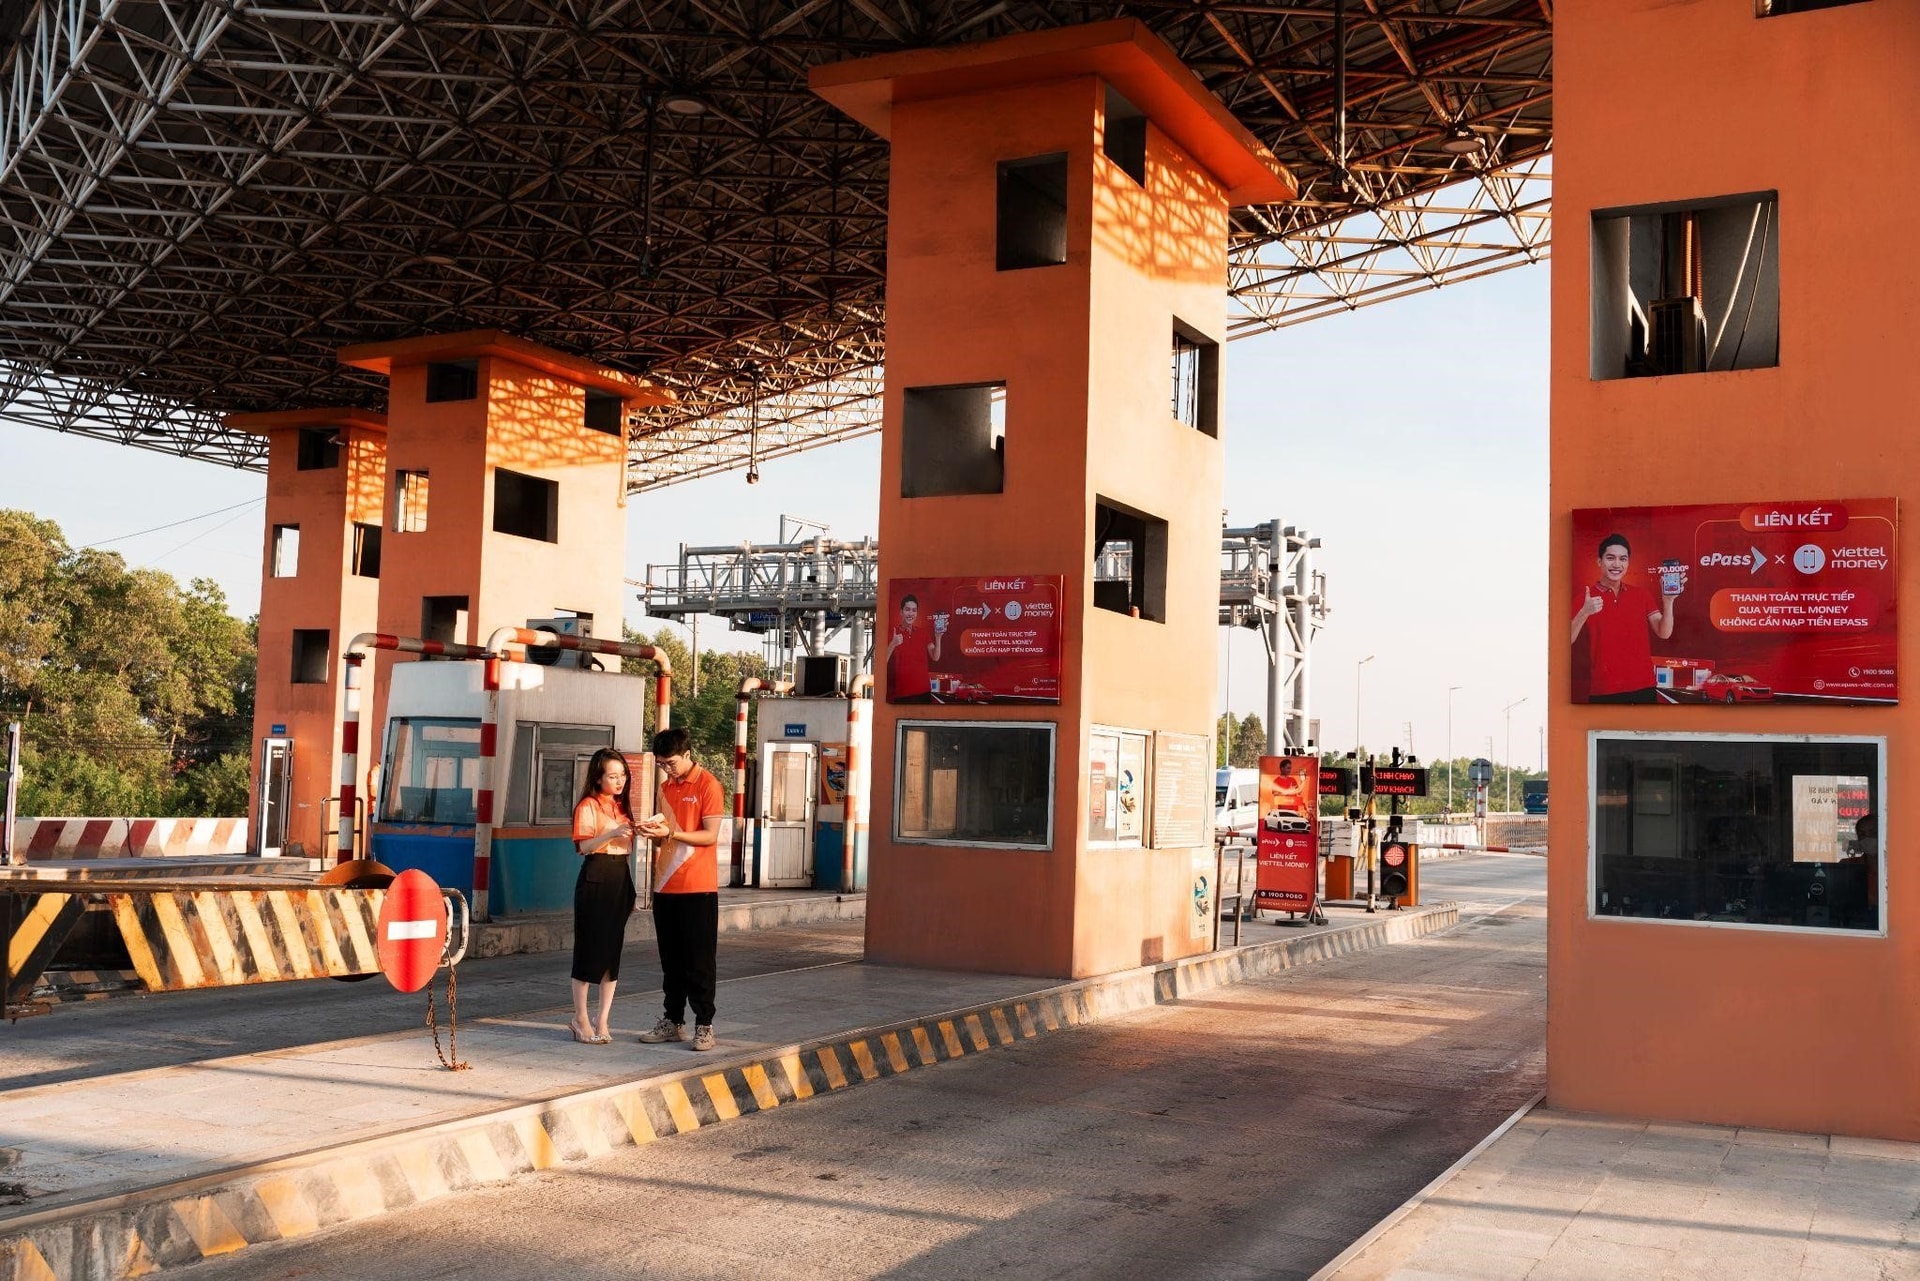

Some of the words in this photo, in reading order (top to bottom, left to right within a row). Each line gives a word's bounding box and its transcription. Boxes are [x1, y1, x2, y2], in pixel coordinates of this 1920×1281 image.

[1754, 511, 1793, 526] LIÊN
[1798, 508, 1832, 525] KẾT
[1832, 547, 1886, 558] viettel
[1700, 552, 1751, 566] ePass
[1832, 559, 1888, 570] money
[984, 580, 1005, 590] LIÊN
[1008, 578, 1026, 590] KẾT
[1730, 594, 1766, 602] THANH
[1769, 592, 1798, 602] TOÁN
[1800, 593, 1828, 602] TRỰC
[1832, 590, 1855, 601] TIẾP
[956, 606, 983, 615] ePass
[1738, 606, 1761, 614] QUA
[1763, 606, 1806, 614] VIETTEL
[1808, 606, 1848, 614] MONEY
[1720, 616, 1756, 626] KHÔNG
[1758, 615, 1780, 626] CẦN
[1782, 618, 1805, 628] NẠP
[1807, 615, 1831, 626] TIỀN
[1834, 618, 1868, 626] EPASS
